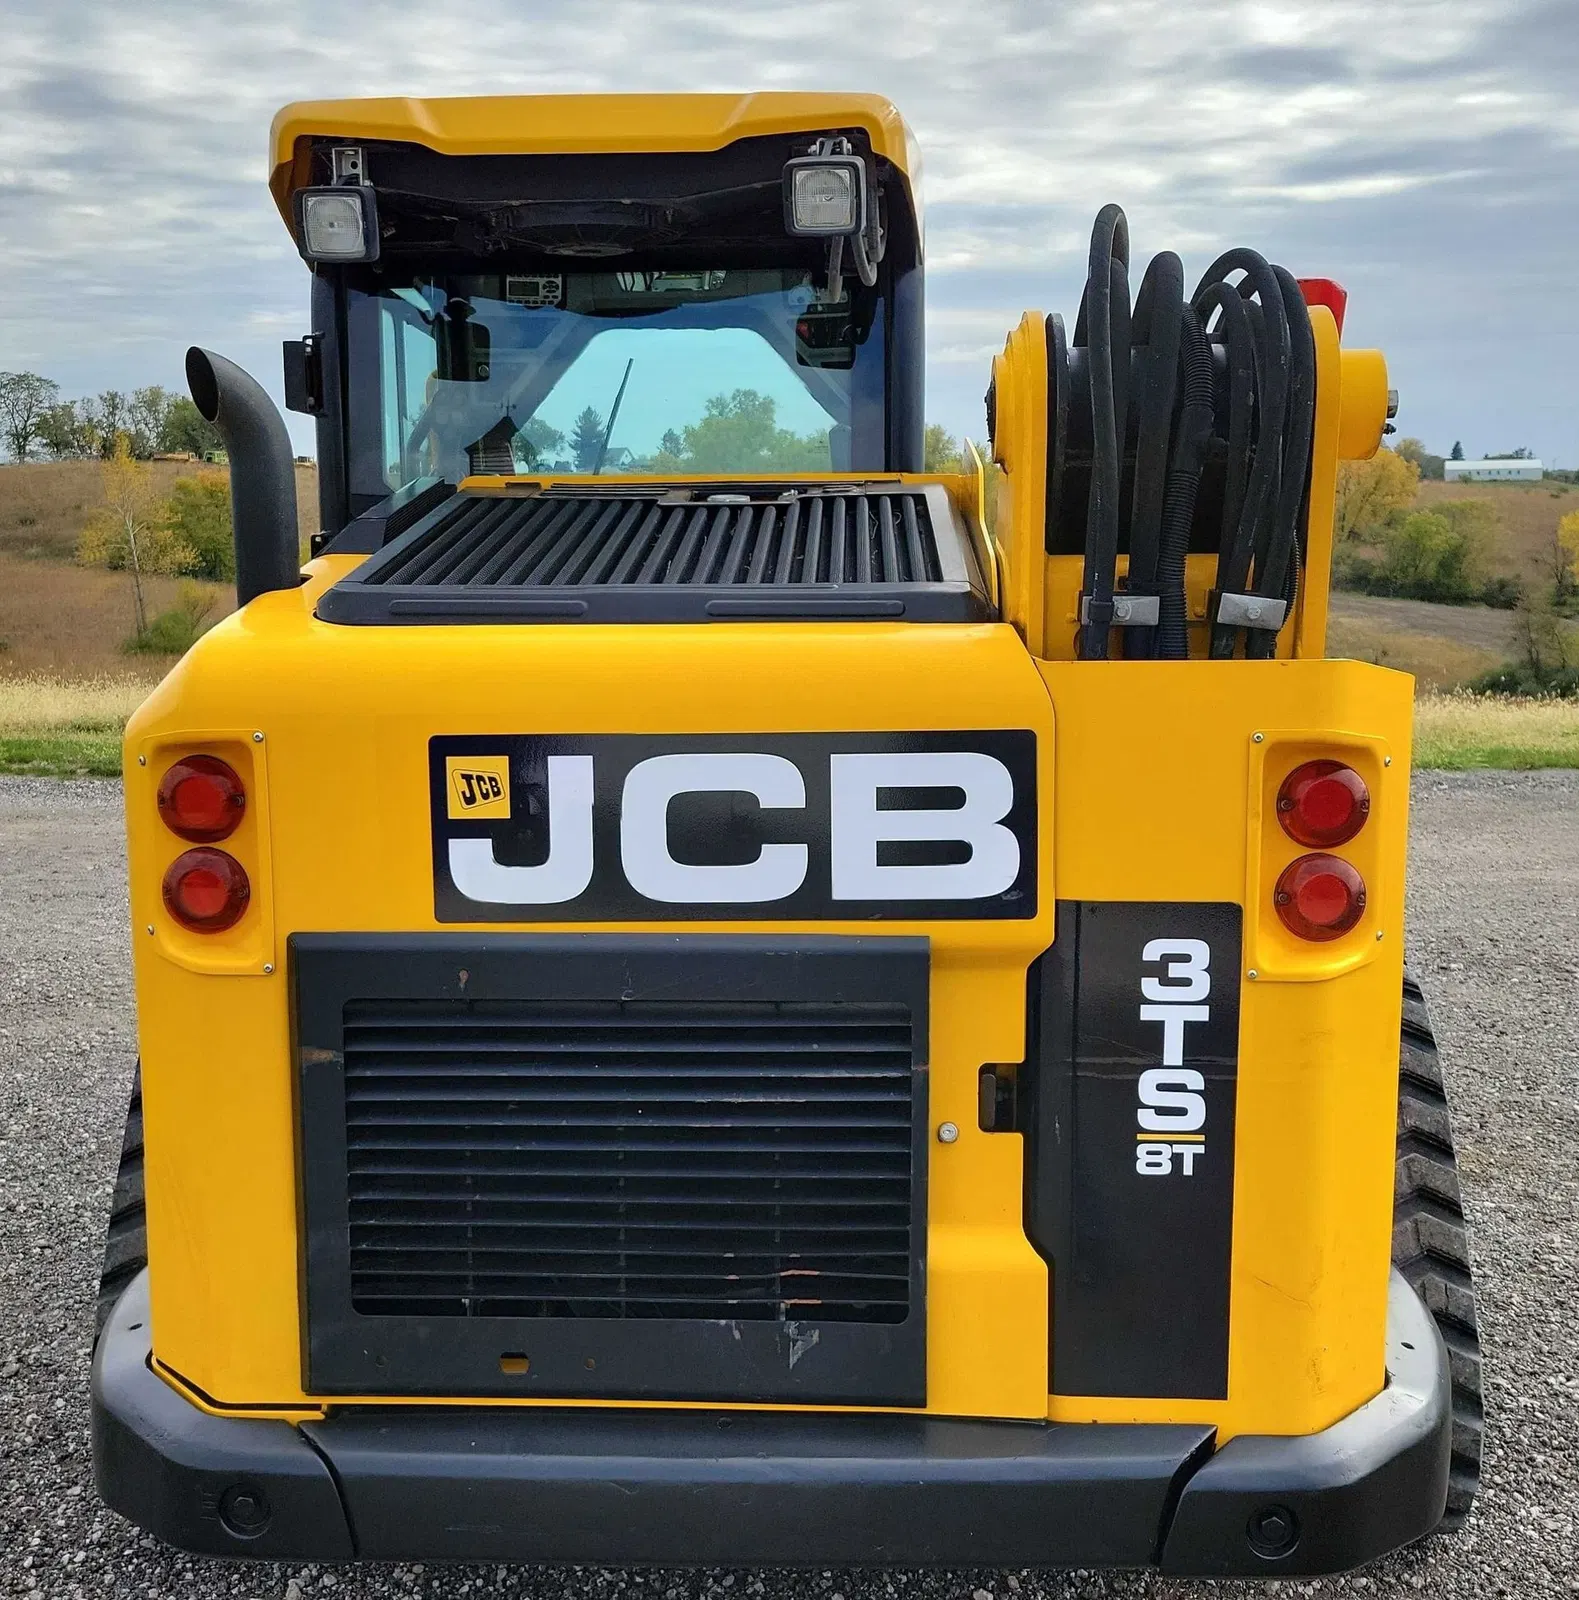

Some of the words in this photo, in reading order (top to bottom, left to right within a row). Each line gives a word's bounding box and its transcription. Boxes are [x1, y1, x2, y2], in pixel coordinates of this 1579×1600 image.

[460, 773, 502, 806] JCB
[448, 752, 1020, 904] JCB
[1136, 1143, 1205, 1176] 8T
